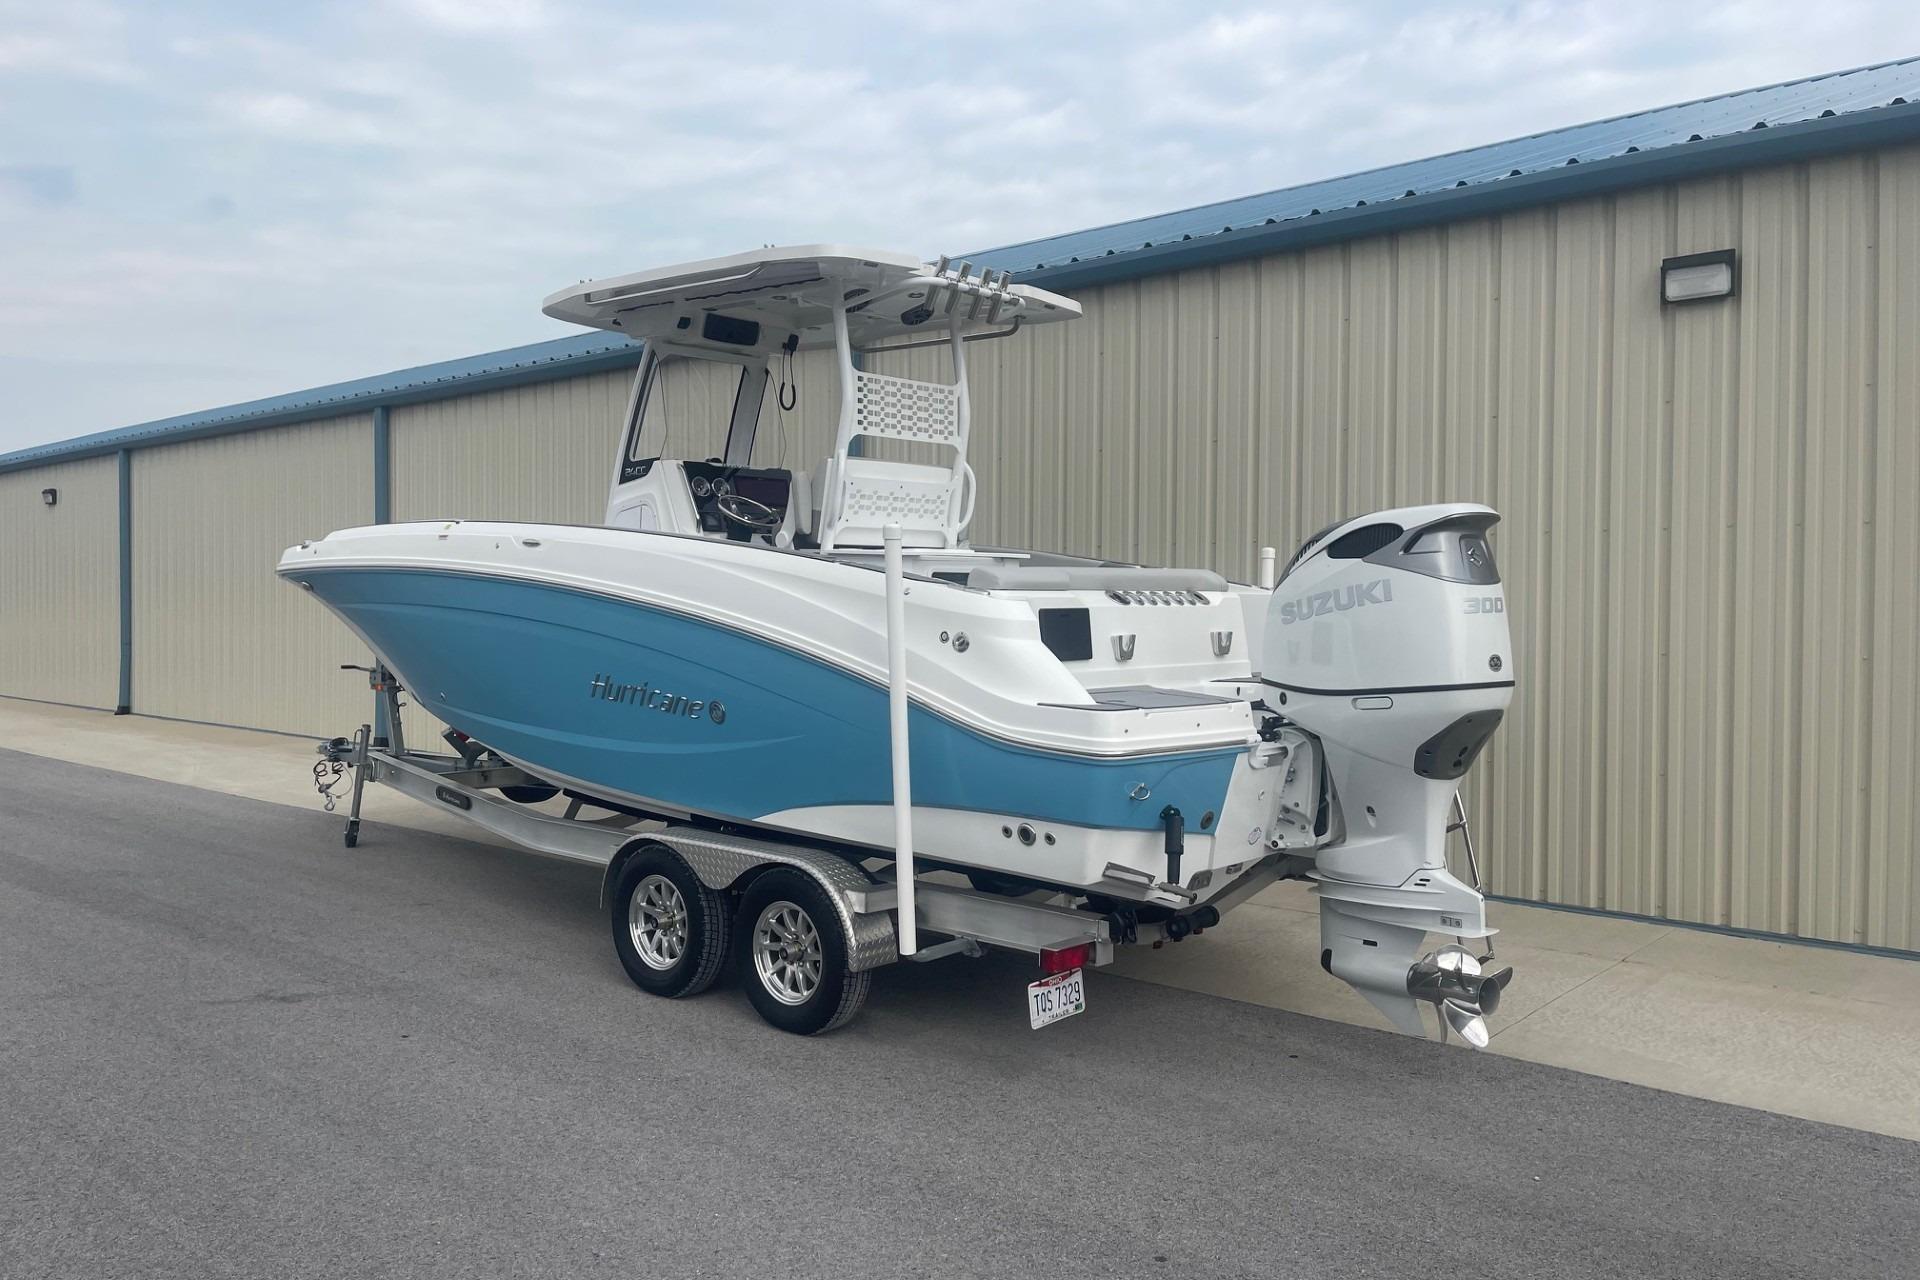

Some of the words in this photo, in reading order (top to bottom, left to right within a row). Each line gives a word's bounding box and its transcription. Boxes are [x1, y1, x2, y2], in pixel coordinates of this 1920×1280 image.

[1281, 578, 1392, 625] SUZUKI
[1463, 597, 1503, 614] 300
[591, 671, 705, 719] Hurricane
[1055, 981, 1081, 1009] 7329
